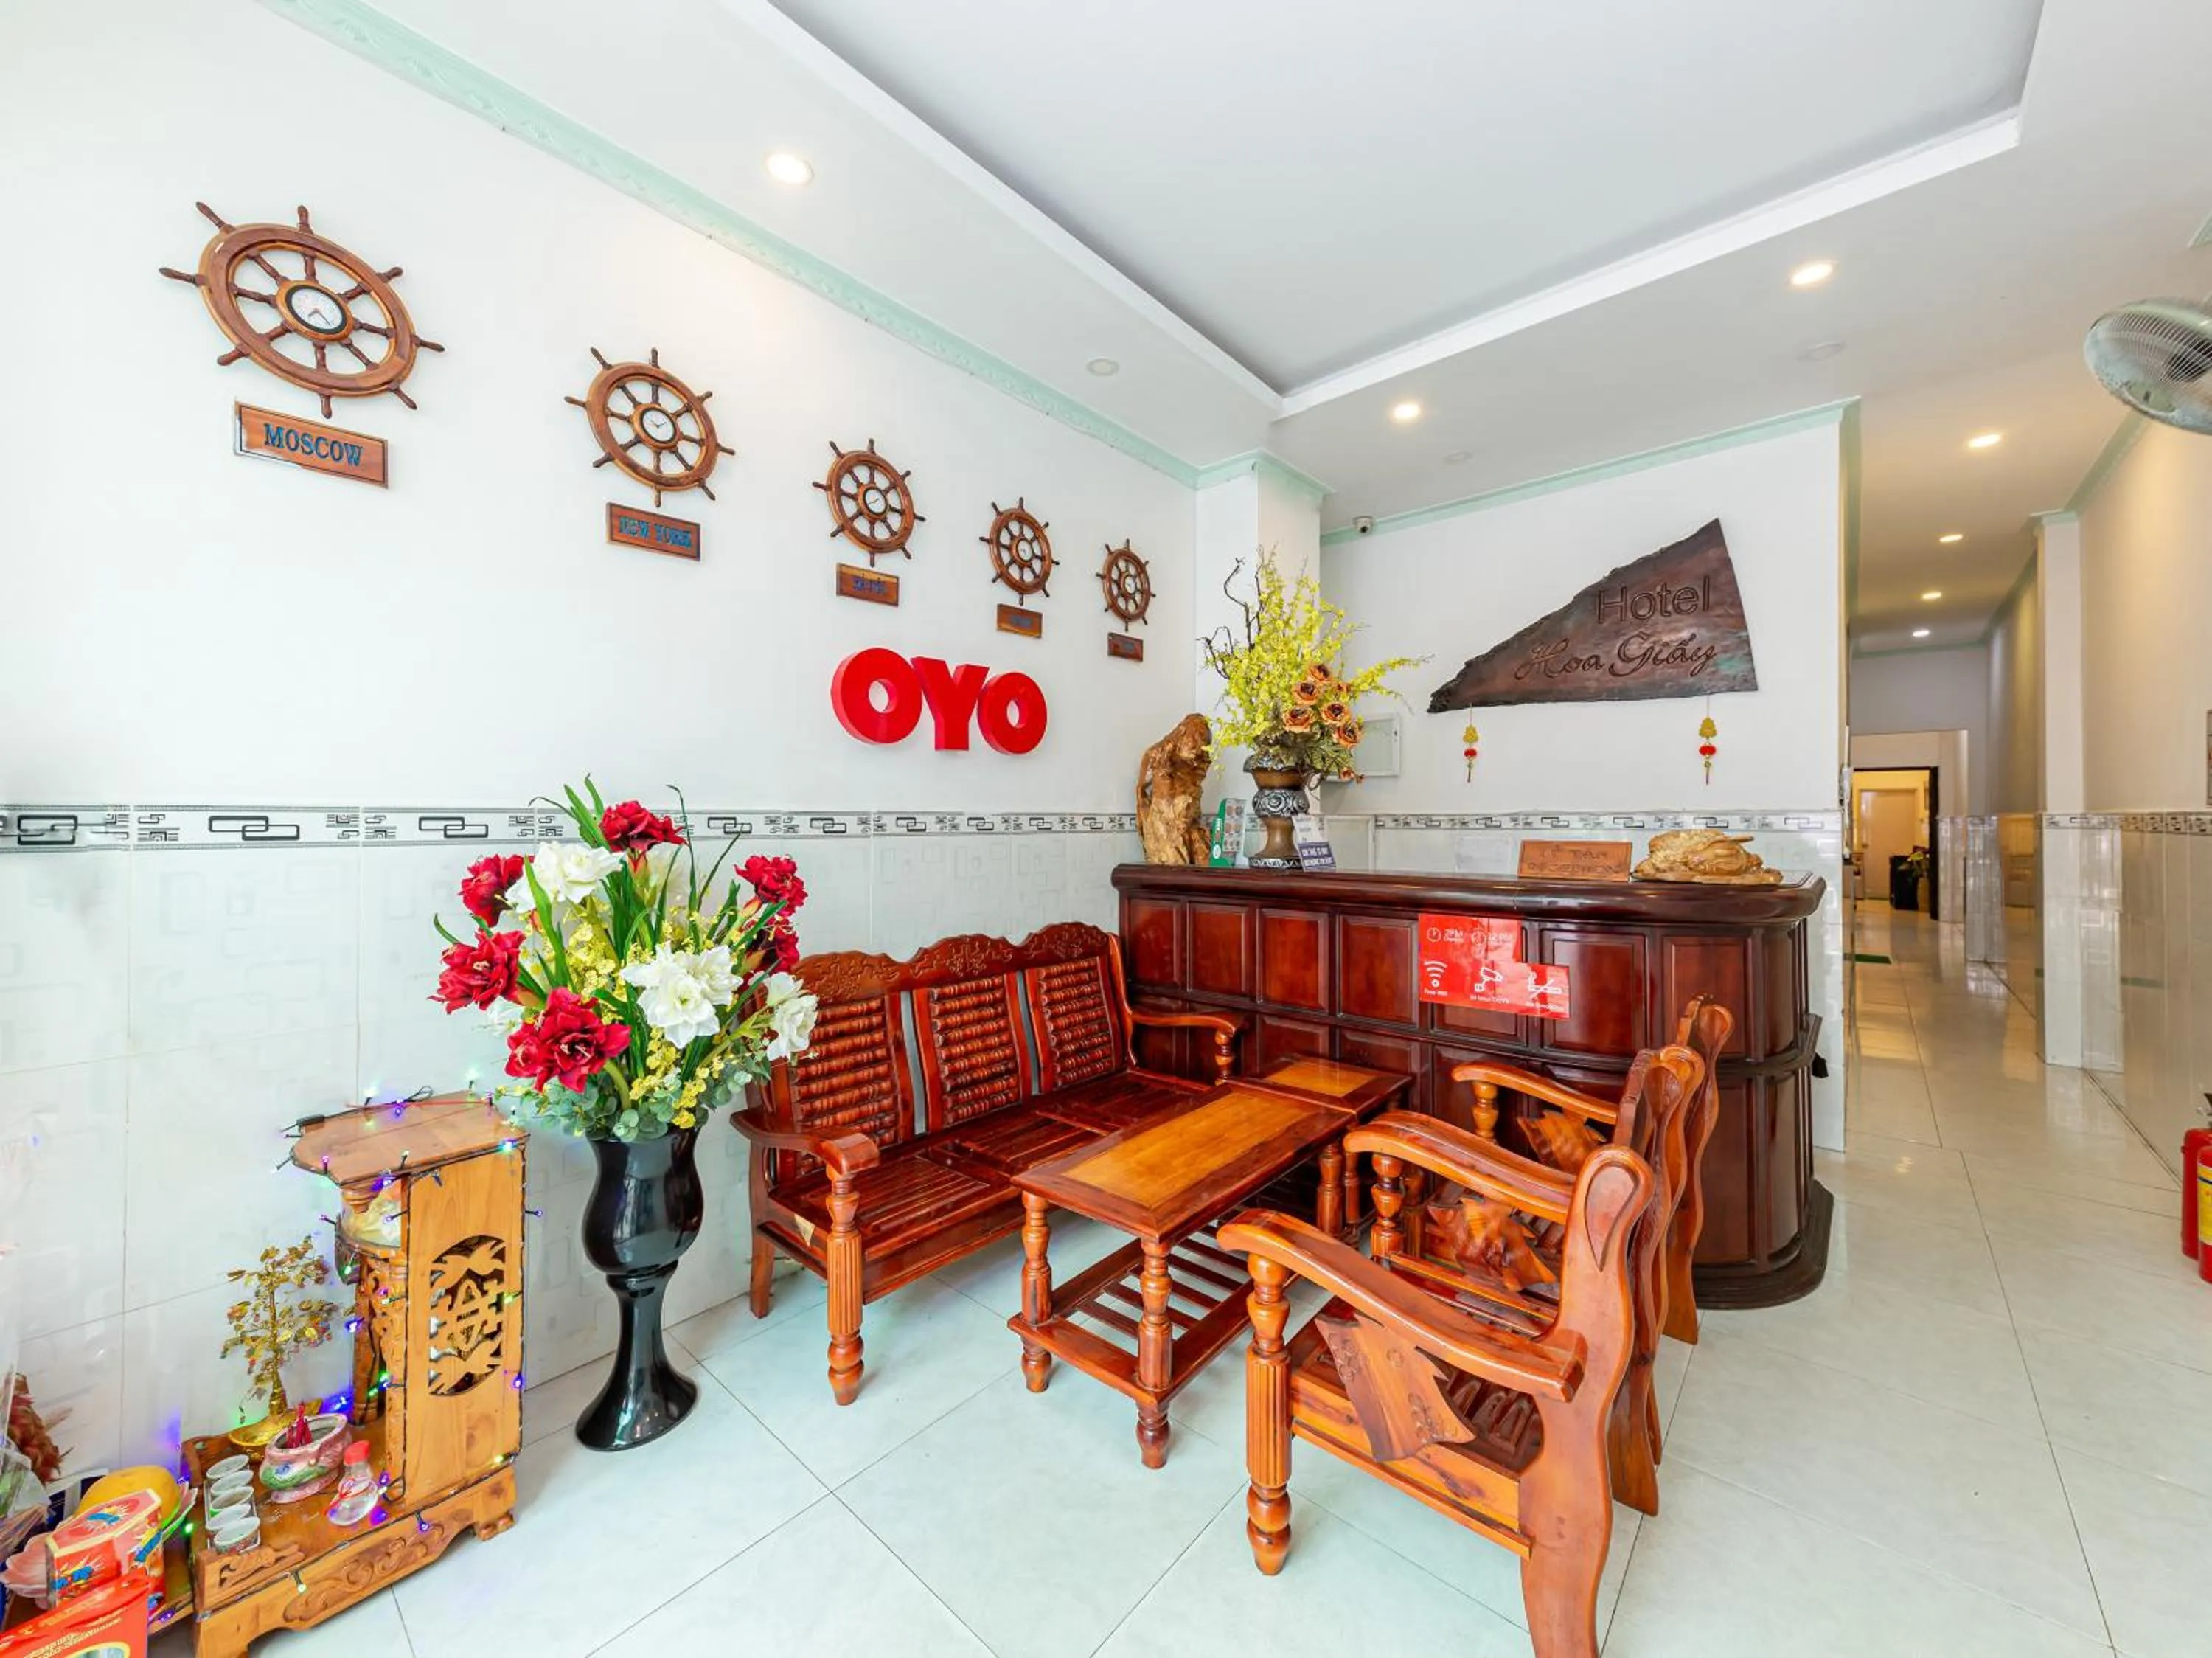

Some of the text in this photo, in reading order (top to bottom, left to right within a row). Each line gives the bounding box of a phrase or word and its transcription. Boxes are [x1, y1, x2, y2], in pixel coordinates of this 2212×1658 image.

[263, 423, 364, 467] MOSCOW
[1596, 575, 1711, 624] Hotel
[1514, 637, 1605, 680] Hoa
[830, 647, 1048, 755] OYO
